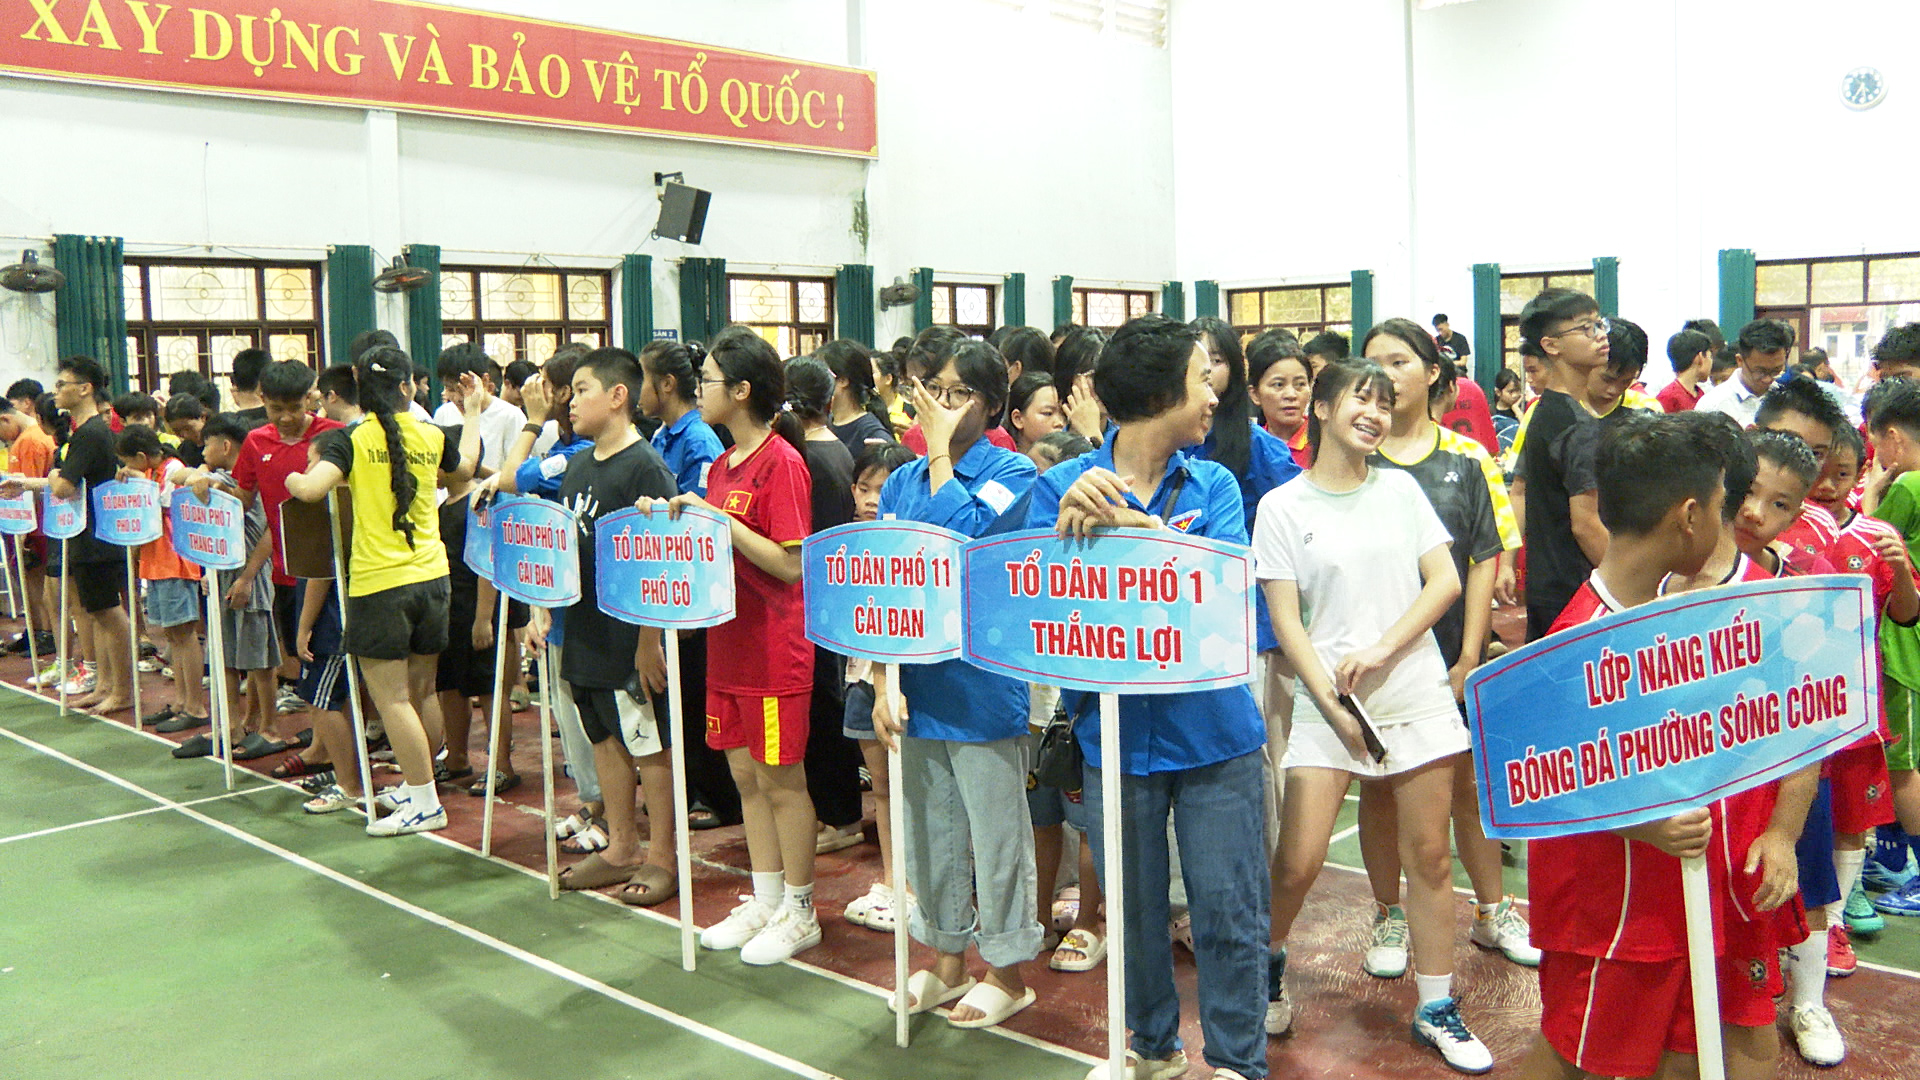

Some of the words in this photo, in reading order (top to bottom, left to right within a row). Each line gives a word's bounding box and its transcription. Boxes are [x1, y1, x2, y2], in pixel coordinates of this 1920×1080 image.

[188, 7, 365, 77] DỰNG
[378, 22, 453, 85] VÀ
[468, 31, 571, 98] BẢO
[581, 51, 641, 115] VỆ
[654, 51, 708, 114] TỔ
[720, 69, 826, 128] QUỐC
[209, 505, 225, 527] PHỐ
[226, 511, 231, 527] 7
[502, 514, 513, 543] TỔ
[515, 519, 533, 546] DÂN
[535, 520, 553, 549] PHỐ
[555, 528, 567, 551] 10
[613, 525, 631, 560] TỔ
[635, 530, 661, 560] DÂN
[665, 526, 693, 561] PHỐ
[697, 536, 714, 562] 16
[518, 554, 532, 584] CẢI
[534, 563, 554, 588] ĐAN
[826, 545, 846, 584] TỔ
[851, 551, 885, 585] DÂN
[891, 547, 925, 586] PHỐ
[931, 558, 950, 587] 11
[1007, 551, 1041, 596] TỔ
[1050, 558, 1108, 599] DÂN
[1118, 557, 1178, 602] PHỐ
[1189, 571, 1202, 603] 1
[641, 571, 668, 605] PHỐ
[672, 574, 691, 606] CÒ
[855, 597, 882, 635] CẢI
[888, 608, 924, 638] ĐAN
[1031, 612, 1125, 659] THẮNG
[1137, 626, 1181, 669] LỢI
[1585, 647, 1631, 706] LỚP
[1637, 636, 1705, 694] NĂNG
[1709, 610, 1761, 675] KIẾU
[1507, 747, 1575, 805] BÓNG
[1580, 729, 1615, 787] ĐÁ
[1618, 711, 1714, 776] PHƯỜNG
[1720, 695, 1779, 748] SÔNG
[1787, 675, 1847, 730] CÔNG
